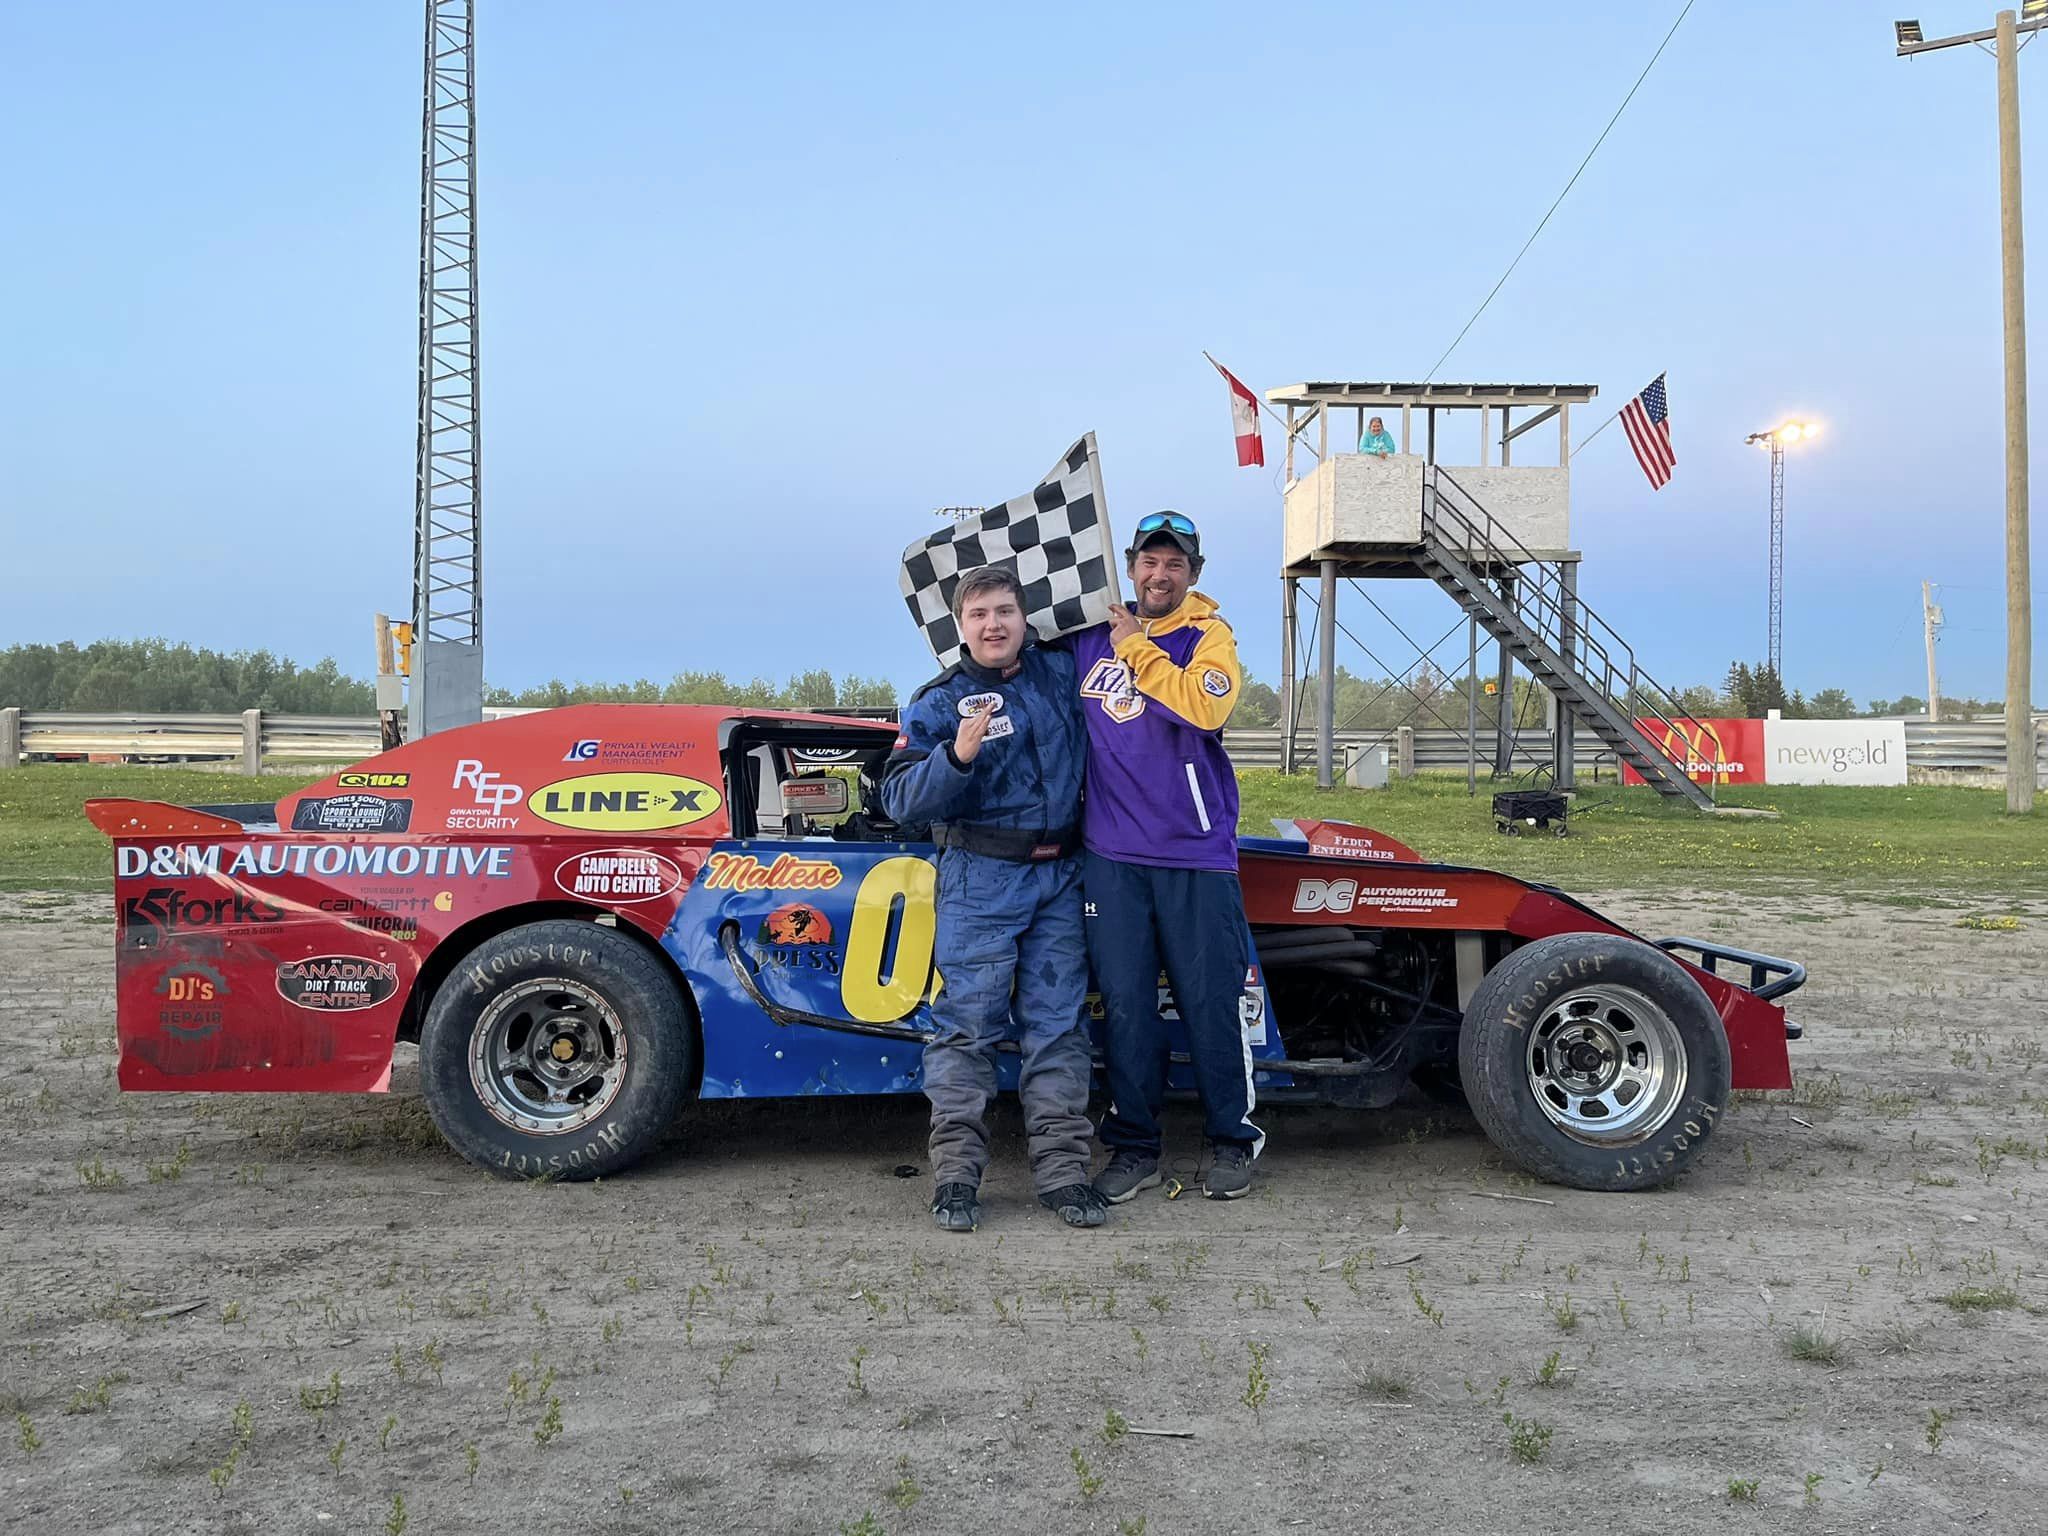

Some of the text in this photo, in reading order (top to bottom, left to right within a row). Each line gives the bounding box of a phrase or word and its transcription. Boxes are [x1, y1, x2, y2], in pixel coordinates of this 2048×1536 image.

[569, 741, 600, 759] IG
[604, 742, 696, 750] PRIVATE WEALTH
[1778, 739, 1887, 772] newgold
[326, 795, 386, 806] FORKS SOUTH
[324, 807, 382, 816] SPORTS LOUNGE
[446, 818, 519, 829] SECURITY
[1312, 845, 1395, 860] ENTERPRISES
[117, 845, 513, 879] D&M AUTOMOTIVE
[579, 857, 658, 876] CAMPBELL'S
[704, 853, 843, 891] Maltese
[574, 875, 661, 894] AUTO CENTRE
[1361, 887, 1446, 897] AUTOMOTIVE
[319, 897, 430, 912] carhartt
[1358, 897, 1458, 907] PERFORMANCE
[390, 930, 417, 941] PROS
[279, 963, 394, 980] CANADIAN
[465, 944, 592, 994] Hoosier
[168, 977, 214, 1000] DJ's
[305, 979, 367, 992] DIRT TRACK
[298, 993, 371, 1006] CENTRE
[1502, 954, 1611, 1033] Hoosier
[160, 1011, 221, 1023] REPAIR
